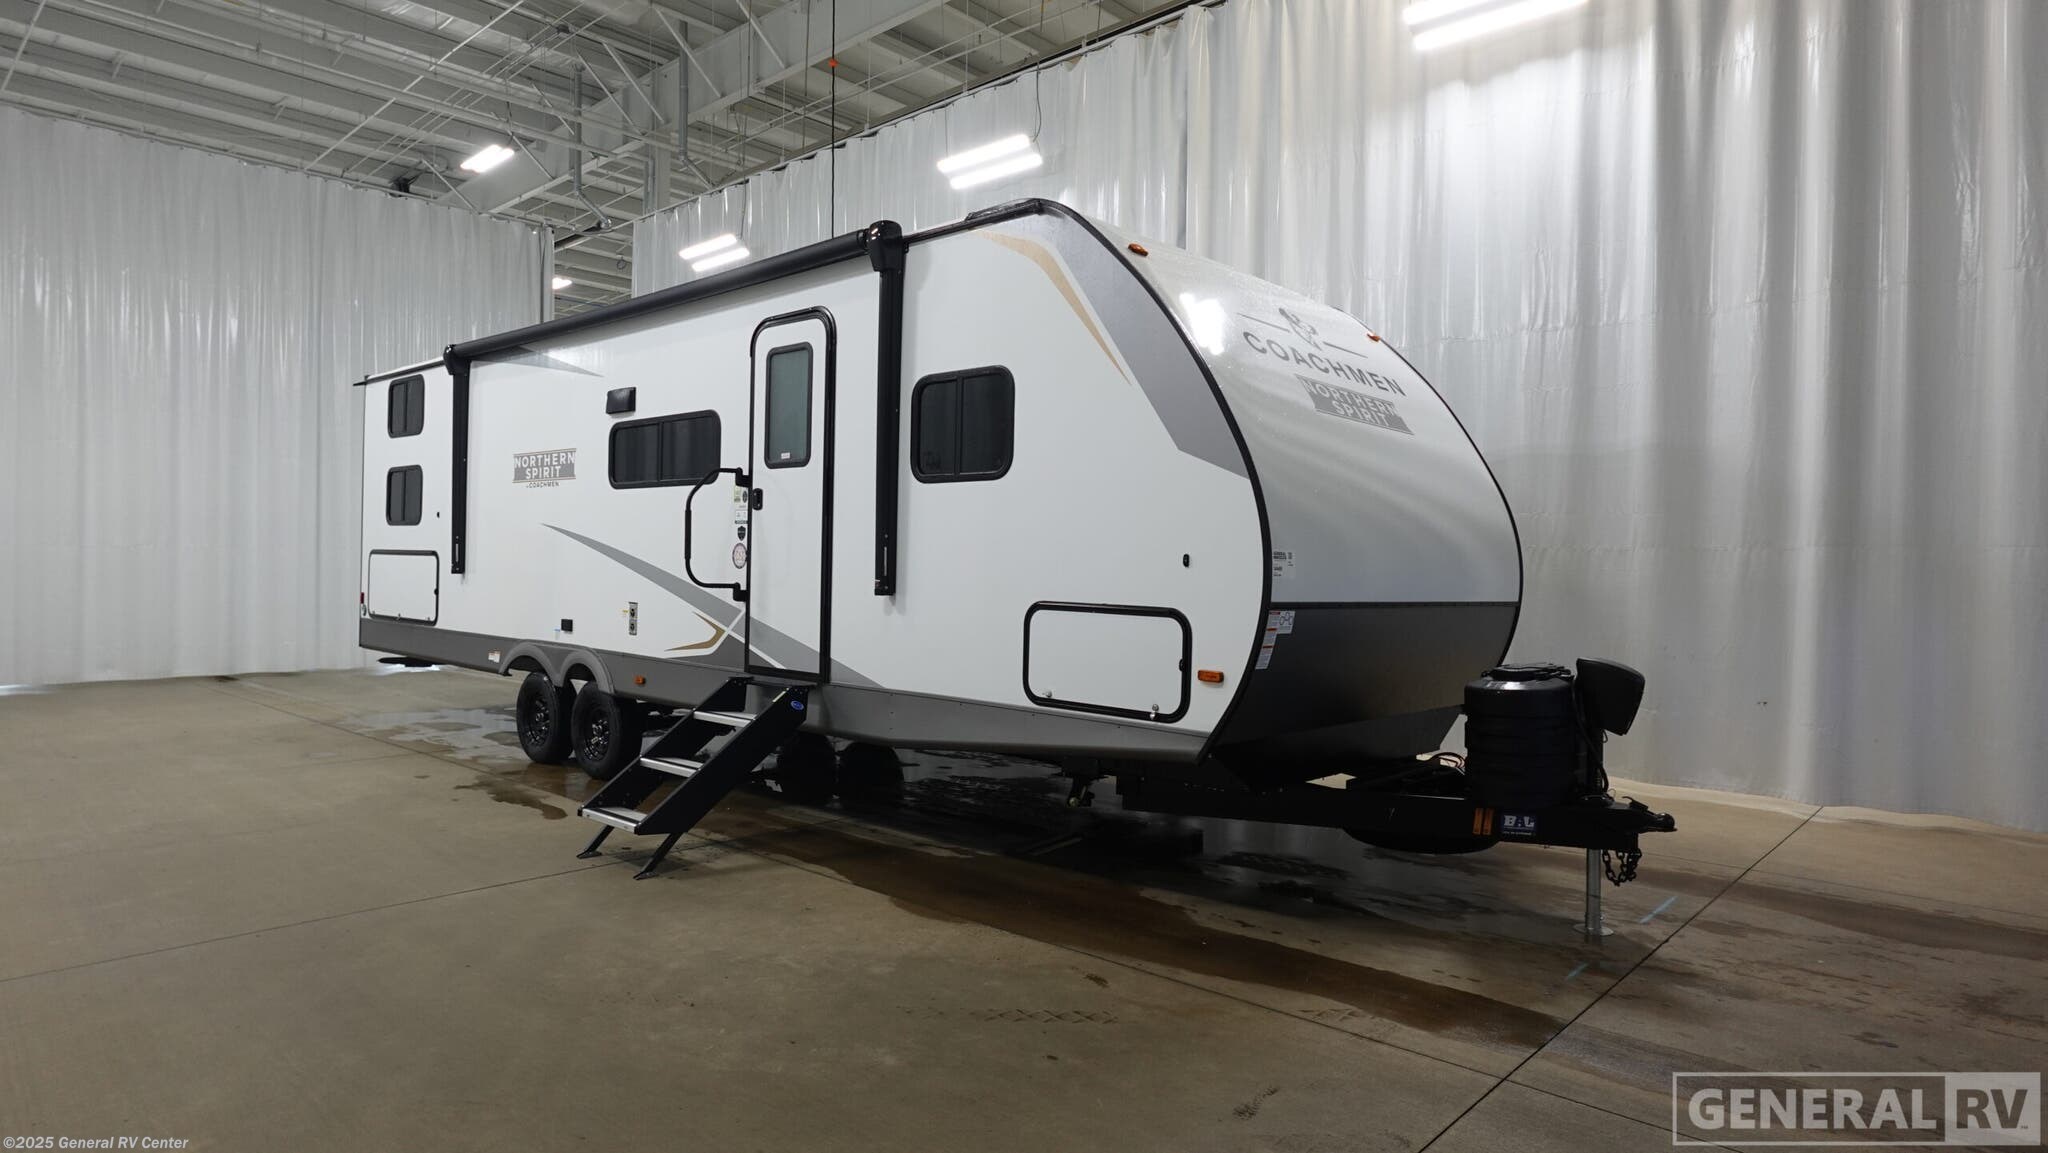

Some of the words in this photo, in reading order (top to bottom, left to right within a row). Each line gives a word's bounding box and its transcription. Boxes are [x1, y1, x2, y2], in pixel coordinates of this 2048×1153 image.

[1243, 331, 1406, 396] COACHMEN
[1301, 378, 1396, 417] NORTHERN
[1332, 400, 1388, 427] SPIRIT
[514, 452, 575, 468] NORTHERN
[526, 466, 561, 479] SPIRIT
